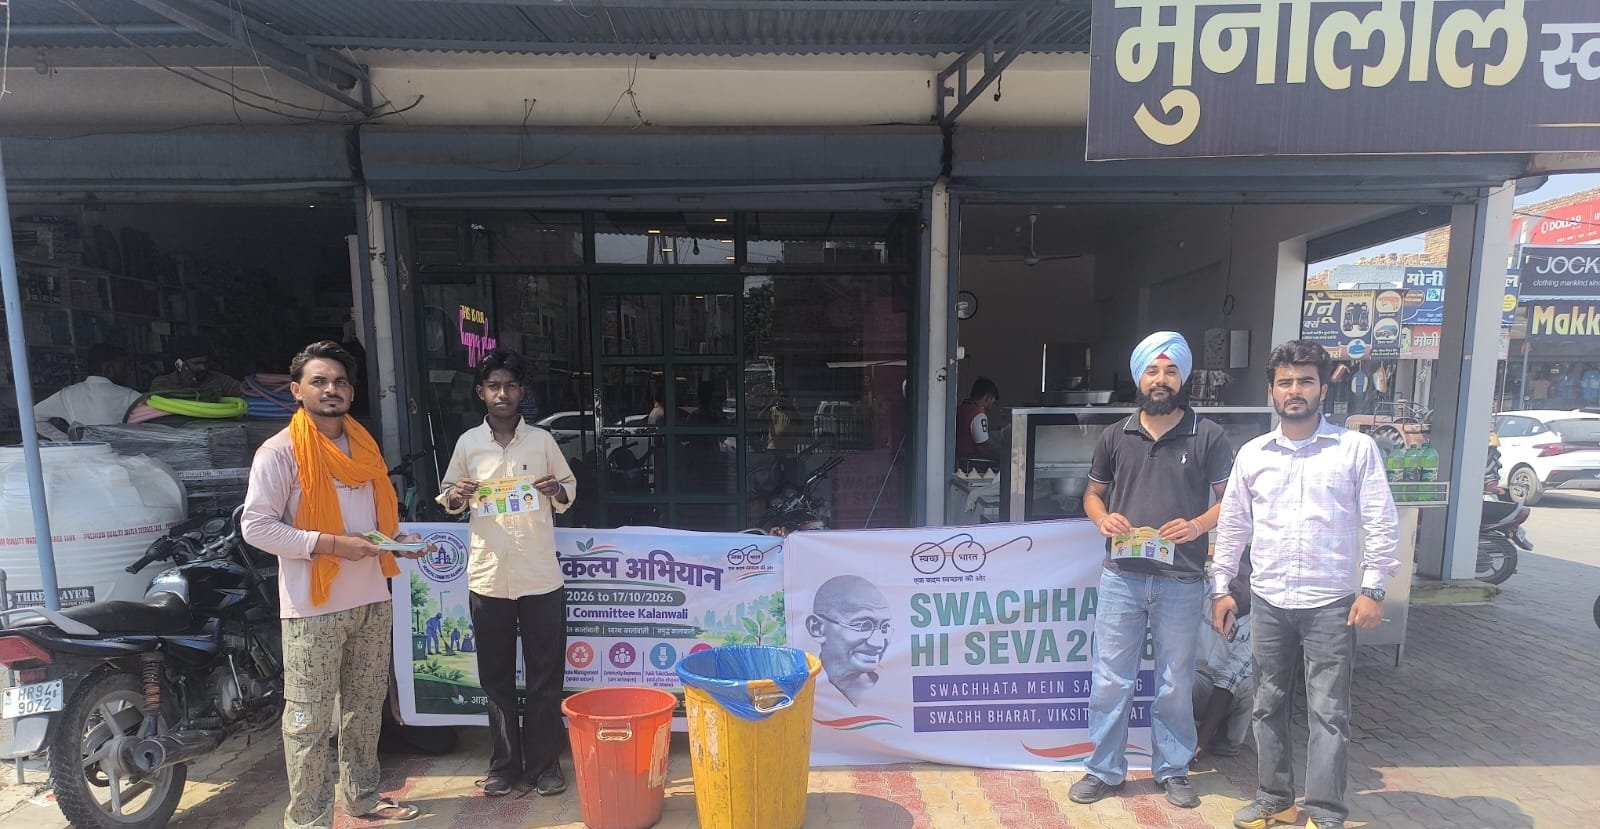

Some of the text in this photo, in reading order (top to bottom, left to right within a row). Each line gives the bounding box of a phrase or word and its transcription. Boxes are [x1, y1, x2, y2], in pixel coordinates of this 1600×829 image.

[1536, 256, 1600, 274] JOCK
[1407, 270, 1443, 286] मोनी
[1532, 305, 1600, 335] Makk
[25, 536, 37, 545] WATE
[556, 550, 723, 591] ंकल्प अभियान
[15, 588, 90, 602] THRE AYER
[566, 591, 673, 603] 2026 to 17/10/2026
[573, 607, 635, 619] Committee
[638, 608, 688, 620] Kalanwali
[910, 587, 1098, 628] SWACHHA
[911, 628, 1155, 667] HI SEVA 26
[930, 681, 1018, 697] SWACHHATA
[1027, 680, 1064, 694] MEIN
[18, 697, 51, 714] 9072
[929, 708, 1088, 724] SWACHH BHARAT, VIKSIT
